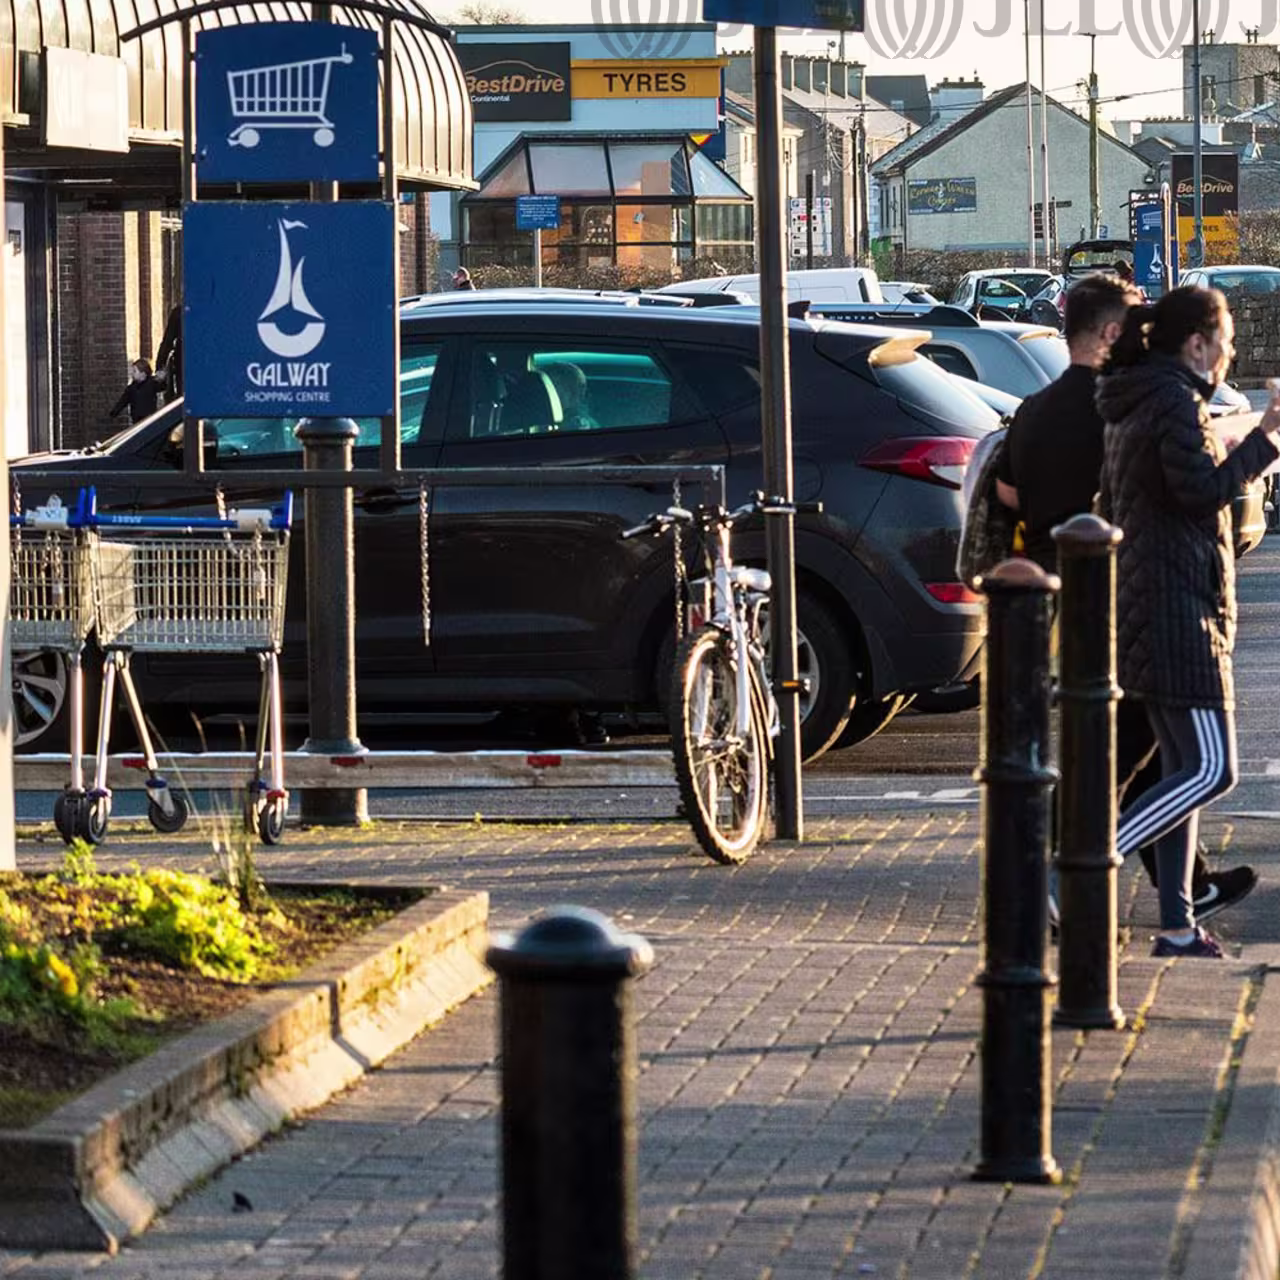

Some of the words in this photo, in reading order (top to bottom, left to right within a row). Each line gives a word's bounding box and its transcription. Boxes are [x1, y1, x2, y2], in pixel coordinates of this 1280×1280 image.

[603, 73, 687, 92] TYRES
[246, 362, 332, 387] GALWAY
[244, 391, 294, 403] SHOPPING
[295, 391, 331, 403] CENTRE
